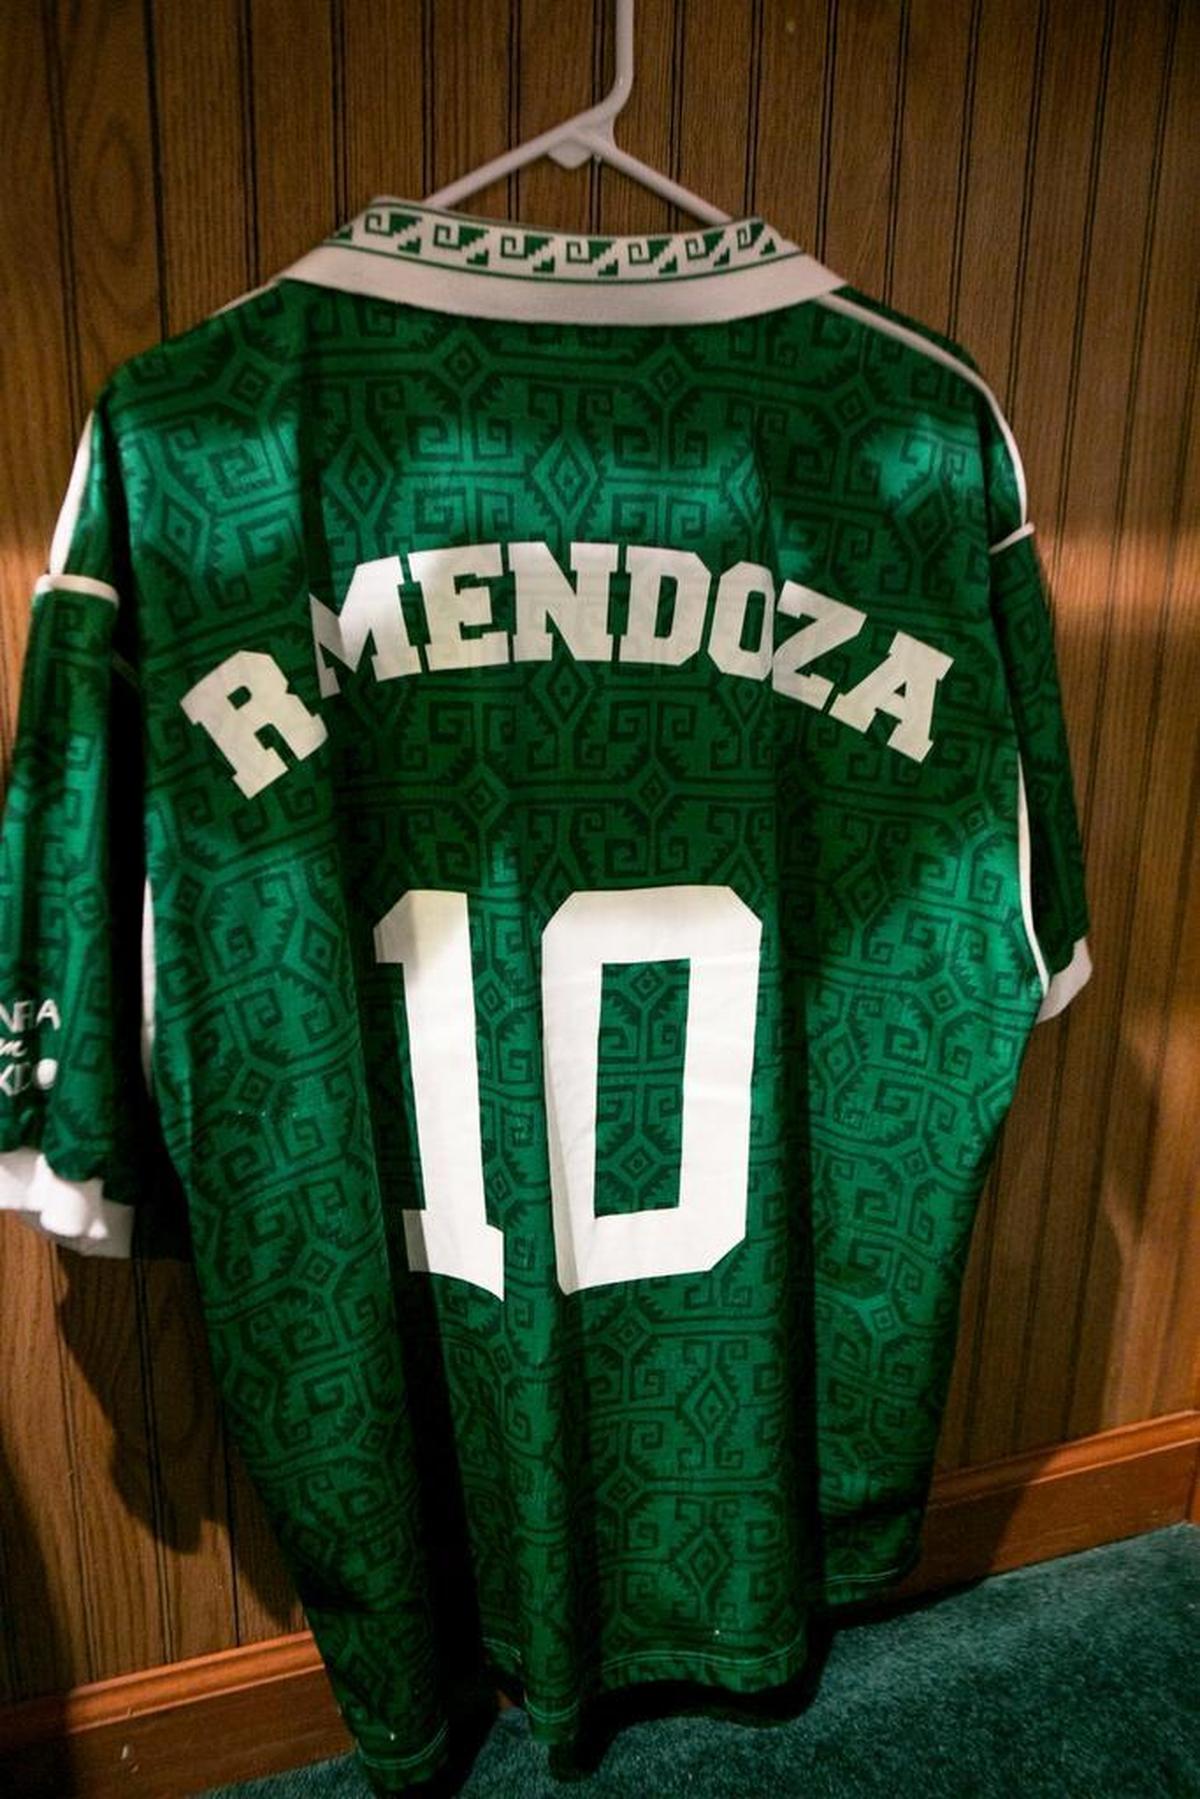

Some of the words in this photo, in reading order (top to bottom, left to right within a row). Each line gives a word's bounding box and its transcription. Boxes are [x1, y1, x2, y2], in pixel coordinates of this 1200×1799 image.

[180, 650, 328, 800] R
[309, 541, 955, 763] MENDOZA
[373, 884, 764, 1302] 10
